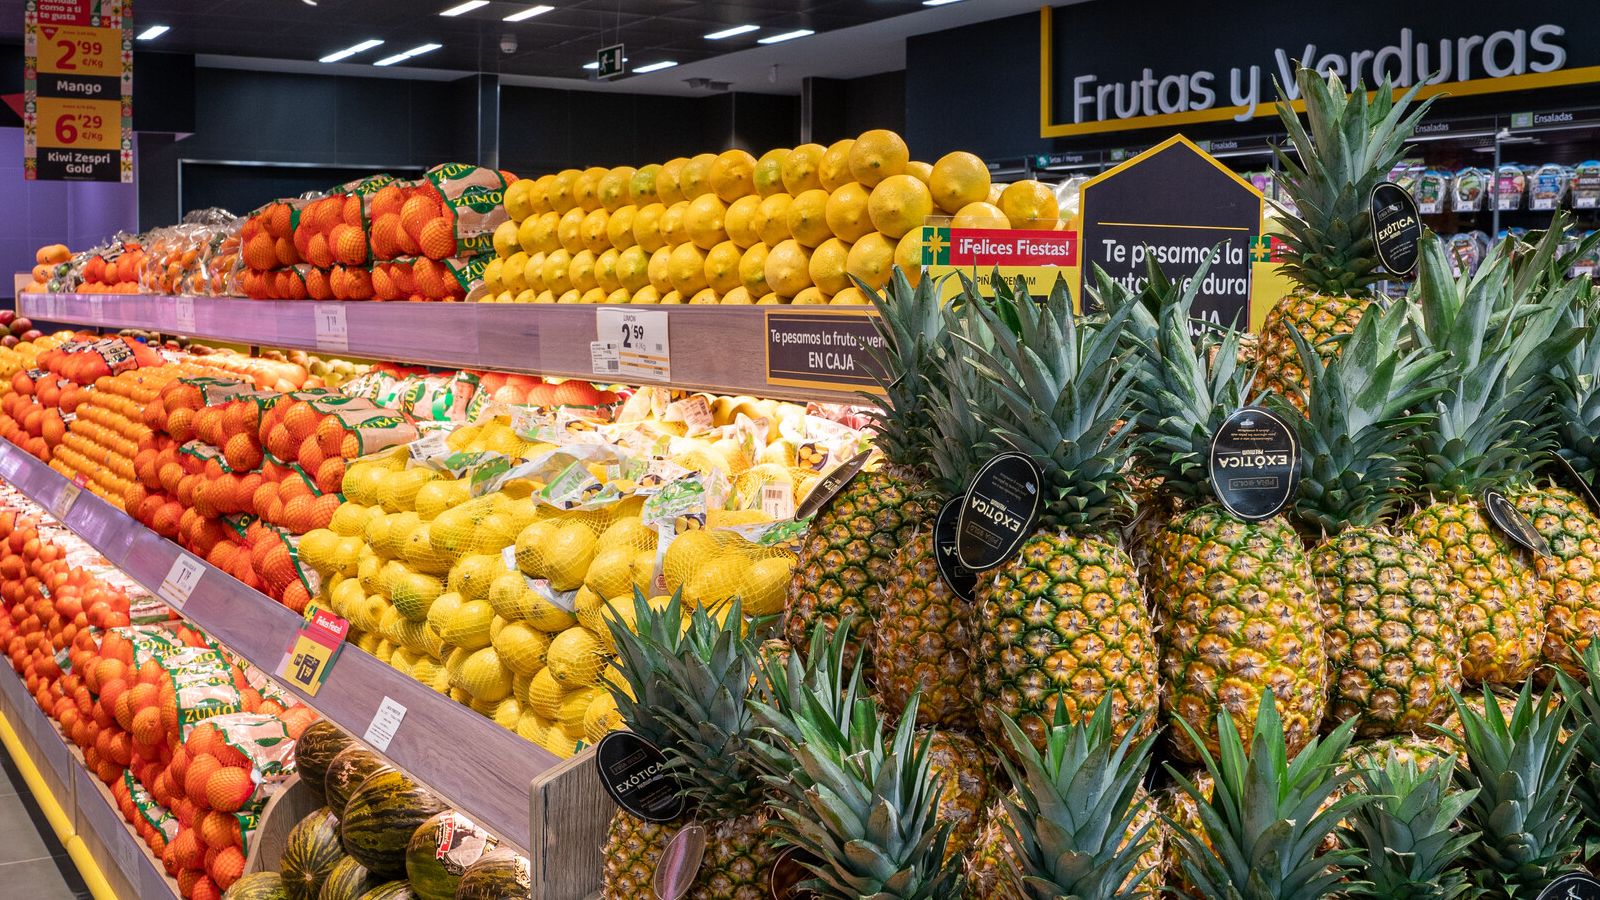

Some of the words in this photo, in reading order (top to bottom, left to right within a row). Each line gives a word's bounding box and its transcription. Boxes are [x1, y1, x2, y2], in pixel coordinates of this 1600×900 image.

[40, 4, 65, 12] como
[74, 5, 82, 14] ti
[56, 40, 103, 70] 2'99
[1073, 68, 1216, 125] Frutas
[1230, 64, 1260, 122] y
[1273, 23, 1567, 101] Verduras
[57, 80, 102, 95] Mango
[1534, 111, 1573, 124] Ensaladas
[55, 113, 103, 145] 6'29
[1414, 122, 1449, 134] Ensaladas
[1211, 140, 1238, 151] Ensaladas
[48, 152, 73, 162] Kiwi
[74, 153, 111, 165] Zespri
[66, 164, 93, 174] Gold
[453, 191, 503, 207] ZUMO
[1378, 216, 1415, 240] EXÓTICA
[959, 238, 1013, 255] ¡Felices
[1016, 239, 1069, 256] Fiestas!
[1102, 239, 1126, 262] Te
[1225, 242, 1243, 265] la
[621, 323, 644, 349] 2'59
[770, 329, 781, 343] Te
[782, 331, 821, 346] pesamos
[822, 330, 831, 346] la
[833, 331, 857, 347] fruta
[808, 351, 823, 369] EN
[825, 352, 855, 371] CAJA
[1218, 454, 1288, 469] EXÓTICA
[971, 496, 1021, 533] EXÓTICA
[185, 704, 236, 723] ZUMO
[615, 762, 664, 793] EXÓTICA
